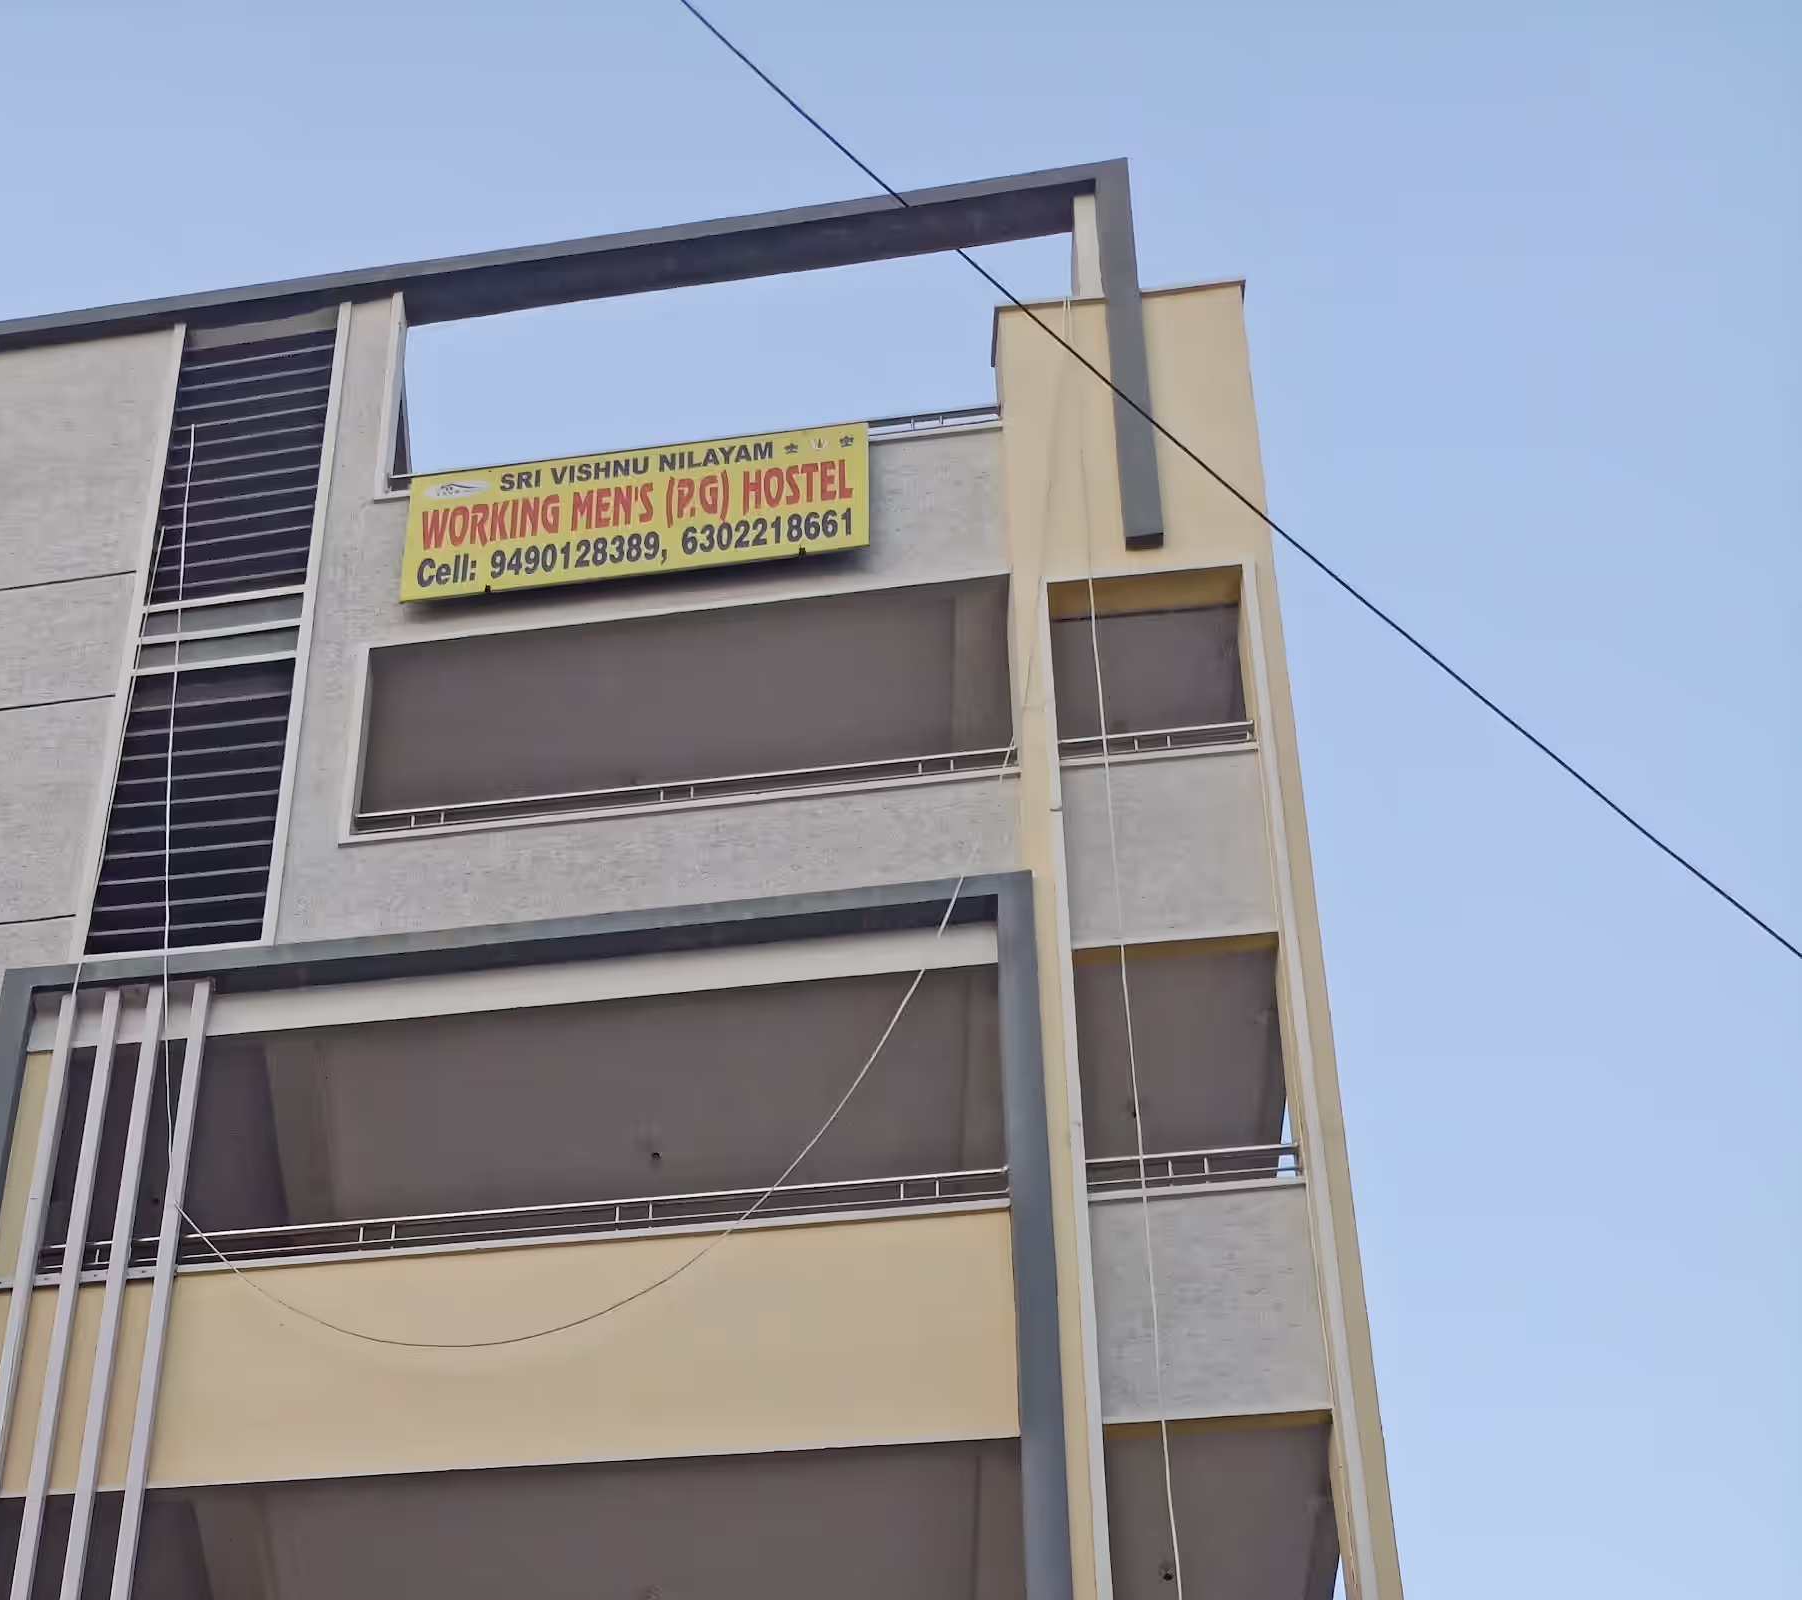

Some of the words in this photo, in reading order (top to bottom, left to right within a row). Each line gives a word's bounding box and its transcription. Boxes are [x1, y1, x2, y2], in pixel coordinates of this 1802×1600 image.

[422, 494, 560, 551] WORKING
[571, 482, 654, 532] MEN'S
[666, 469, 730, 528] (P.G)
[742, 459, 854, 515] HOSTEL
[500, 469, 542, 492] SRI
[551, 456, 649, 485] VISHNU
[659, 441, 774, 472] NILAYAM
[417, 553, 477, 588] Cell:
[490, 531, 667, 579] 9490128389,
[681, 507, 853, 555] 6302218661
